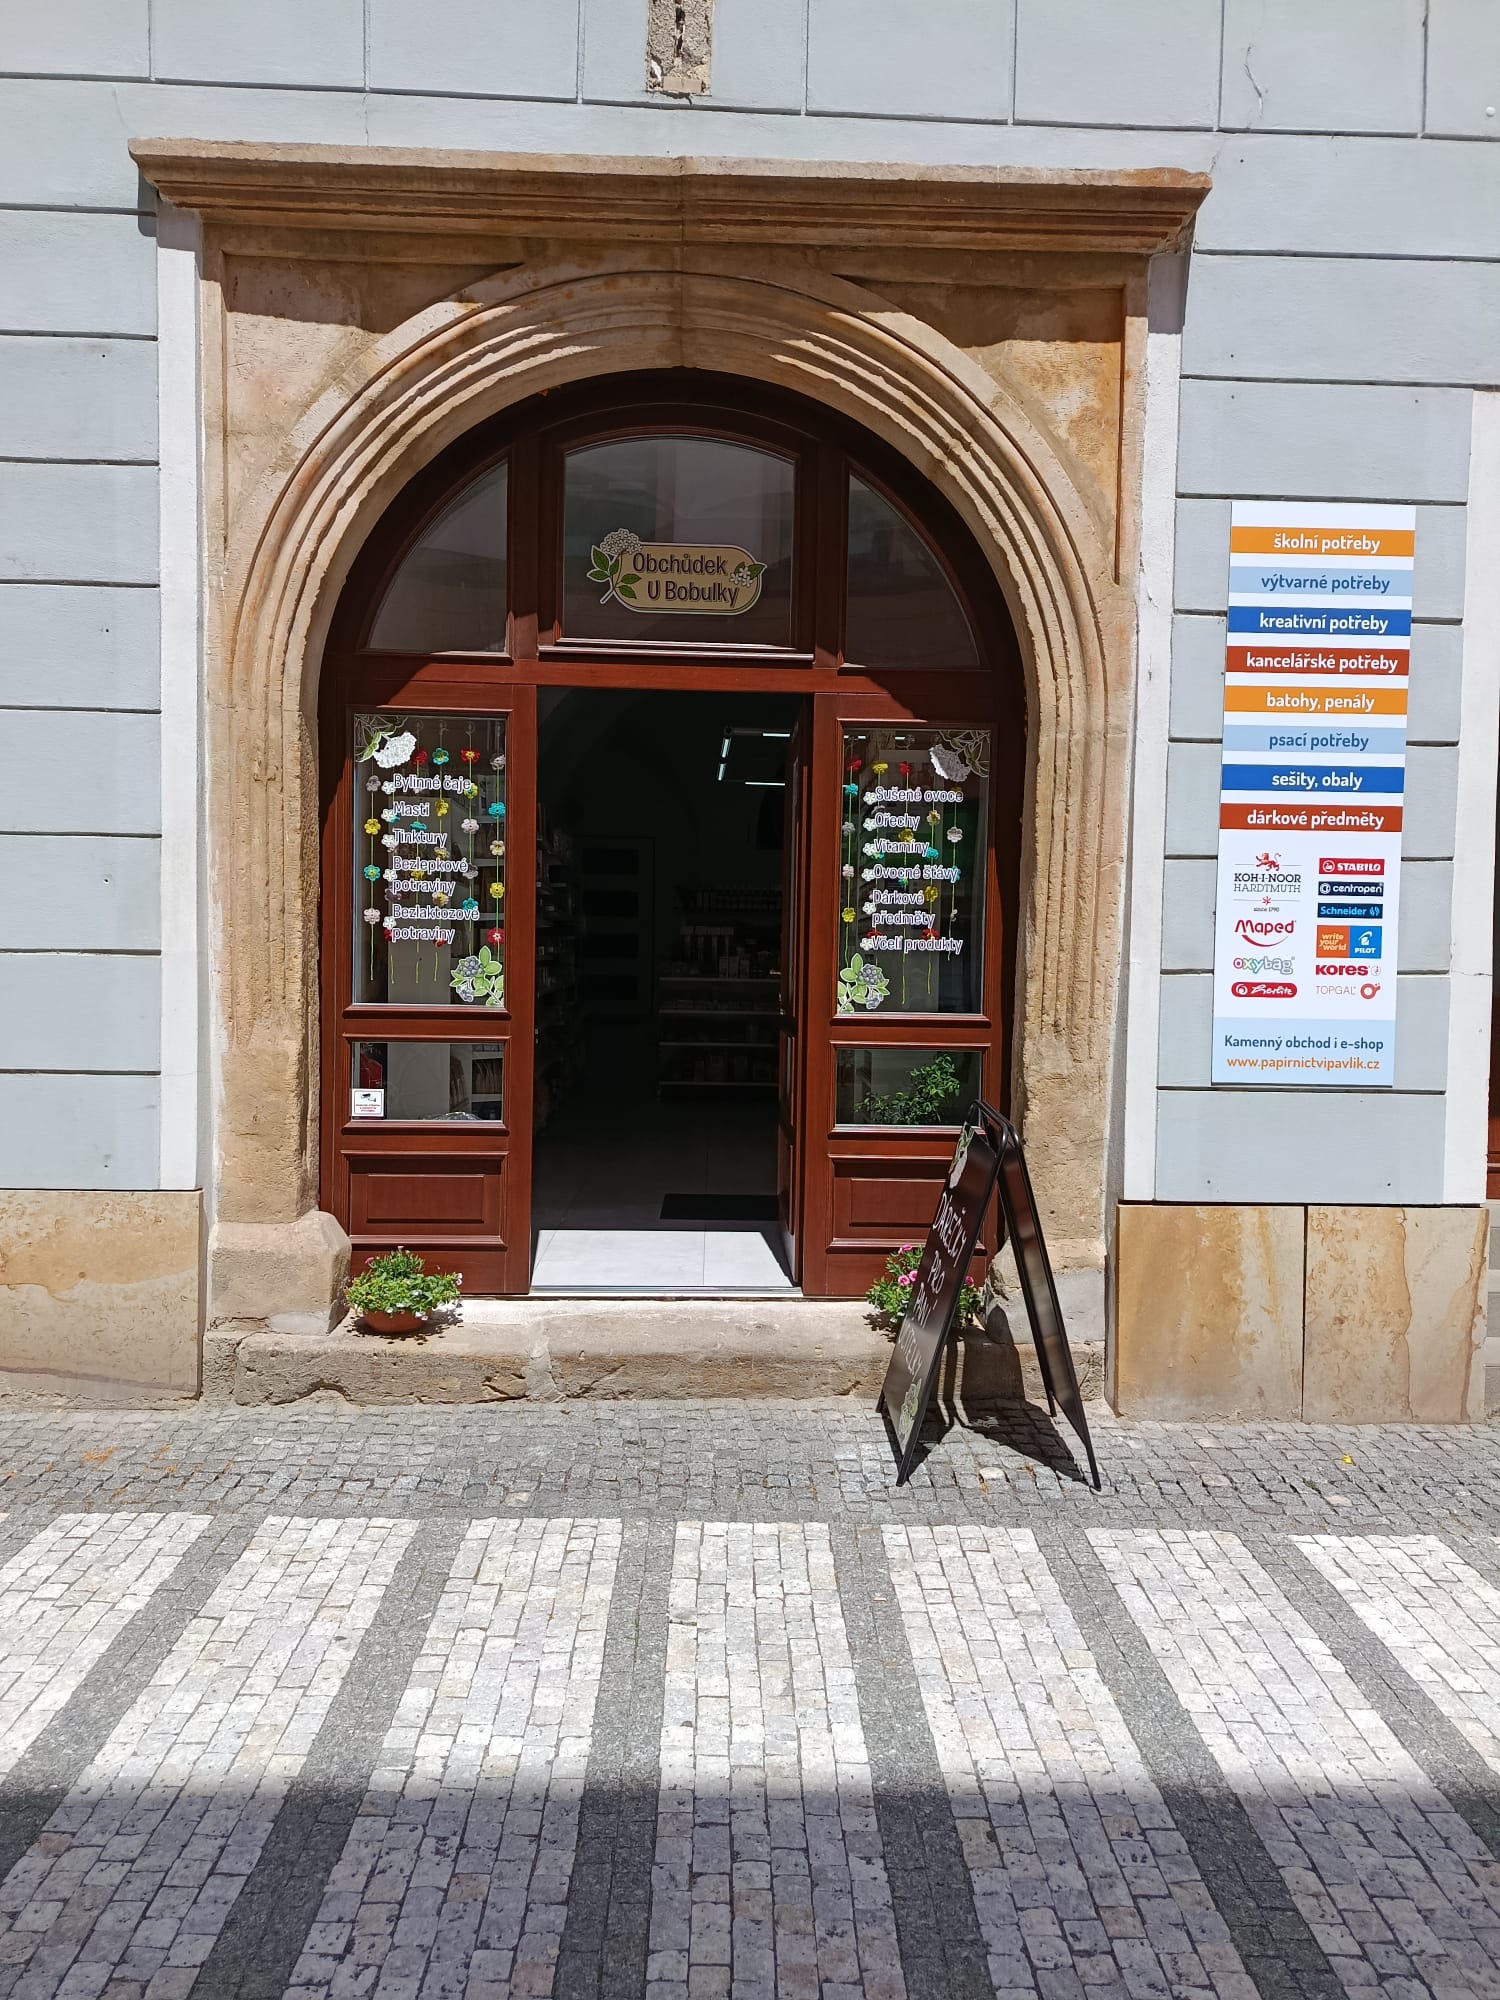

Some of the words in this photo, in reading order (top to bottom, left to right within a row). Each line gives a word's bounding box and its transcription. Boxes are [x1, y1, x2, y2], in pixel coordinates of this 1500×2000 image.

[1273, 533, 1318, 549] školní
[1321, 534, 1380, 554] potřeby
[632, 552, 727, 574] Obchůdek
[1261, 573, 1328, 592] výtvarné
[1331, 574, 1390, 594] potřeby
[647, 581, 660, 600] U
[665, 581, 739, 608] Bobulky
[1259, 613, 1326, 630] kreativní
[1330, 614, 1389, 634] potřeby
[1246, 652, 1336, 669] kancelářské
[1339, 654, 1398, 674] potřeby
[1266, 692, 1321, 712] batohy,
[1324, 693, 1375, 713] penály
[1269, 732, 1308, 750] psací
[1310, 732, 1369, 751] potřeby
[393, 774, 441, 792] Bylinné
[443, 775, 471, 794] čaje
[1271, 771, 1318, 790] sešity,
[1322, 772, 1363, 791] obaly
[876, 786, 922, 802] Sušené
[924, 790, 963, 802] ovoce
[393, 801, 430, 816] Masti
[875, 812, 920, 831] Ořechy
[1247, 810, 1307, 826] dárkové
[1310, 810, 1384, 831] předměty
[393, 828, 447, 848] Tinktury
[874, 838, 929, 857] Vitamíny
[393, 855, 468, 875] Bezlepkové
[873, 864, 921, 880] Ovocné
[923, 865, 958, 883] šťávy
[1337, 863, 1381, 872] STABILO
[392, 878, 456, 896] potraviny
[1234, 873, 1302, 883] KOH-I-NOOR
[872, 890, 924, 905] Dárkové
[1233, 883, 1301, 893] HARDTMUTH
[1332, 884, 1382, 895] centropen
[393, 904, 479, 920] Bezlaktozové
[872, 910, 935, 929] předměty
[1320, 905, 1367, 916] Schneider
[392, 926, 455, 944] potraviny
[1234, 919, 1294, 936] Maped
[1322, 932, 1344, 940] write
[871, 935, 903, 951] Včelí
[904, 937, 963, 955] produkty
[1319, 939, 1339, 947] your
[1233, 955, 1294, 975] oxybag
[1315, 985, 1356, 996] TOPGAL
[1224, 1035, 1283, 1051] Kamenný
[1285, 1036, 1331, 1049] obchod
[1340, 1037, 1384, 1053] e-shop
[1227, 1057, 1380, 1071] www.papirnictvipavlik.cz
[927, 1250, 945, 1294] PRO
